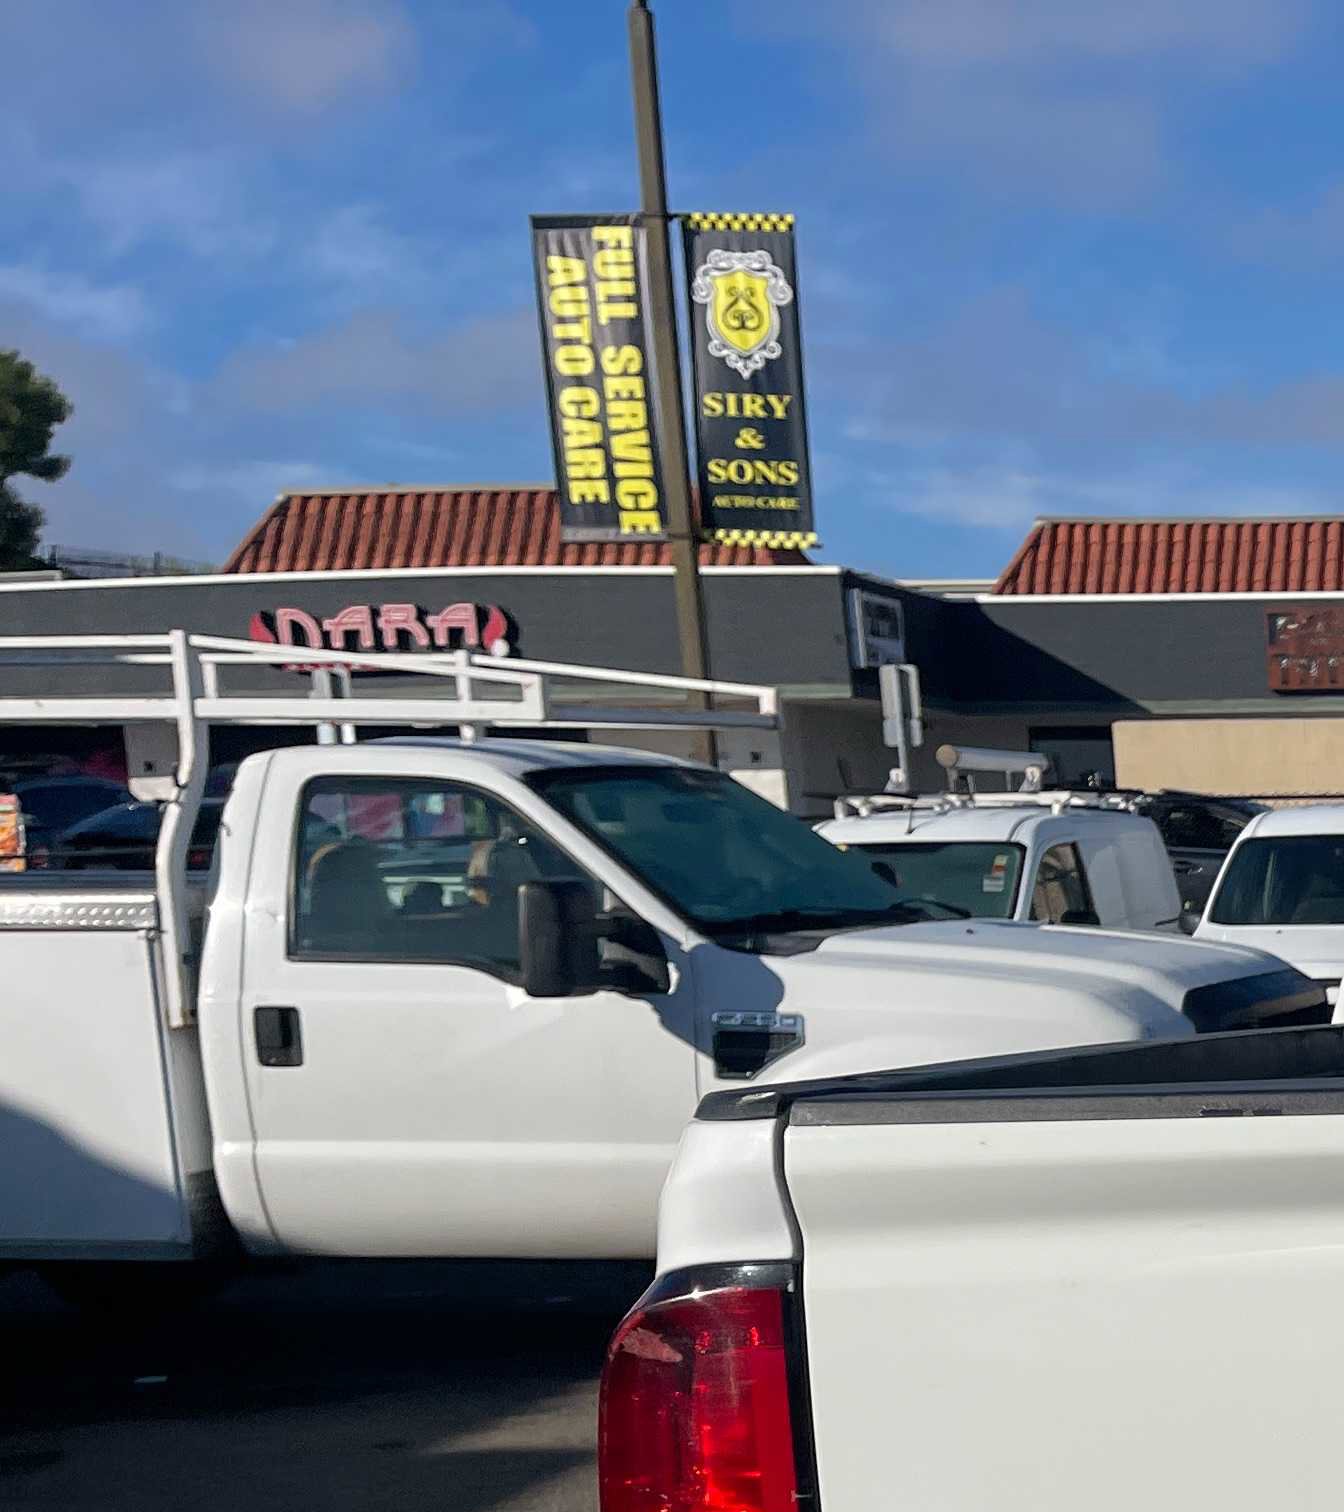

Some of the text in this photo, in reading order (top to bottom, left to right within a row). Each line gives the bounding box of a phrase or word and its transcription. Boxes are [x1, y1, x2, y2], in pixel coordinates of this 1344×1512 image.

[547, 255, 610, 505] AUTO CARE
[591, 225, 662, 535] FULL SERVICE
[703, 391, 793, 419] SIRY
[735, 427, 766, 450] &
[707, 458, 800, 487] SONS
